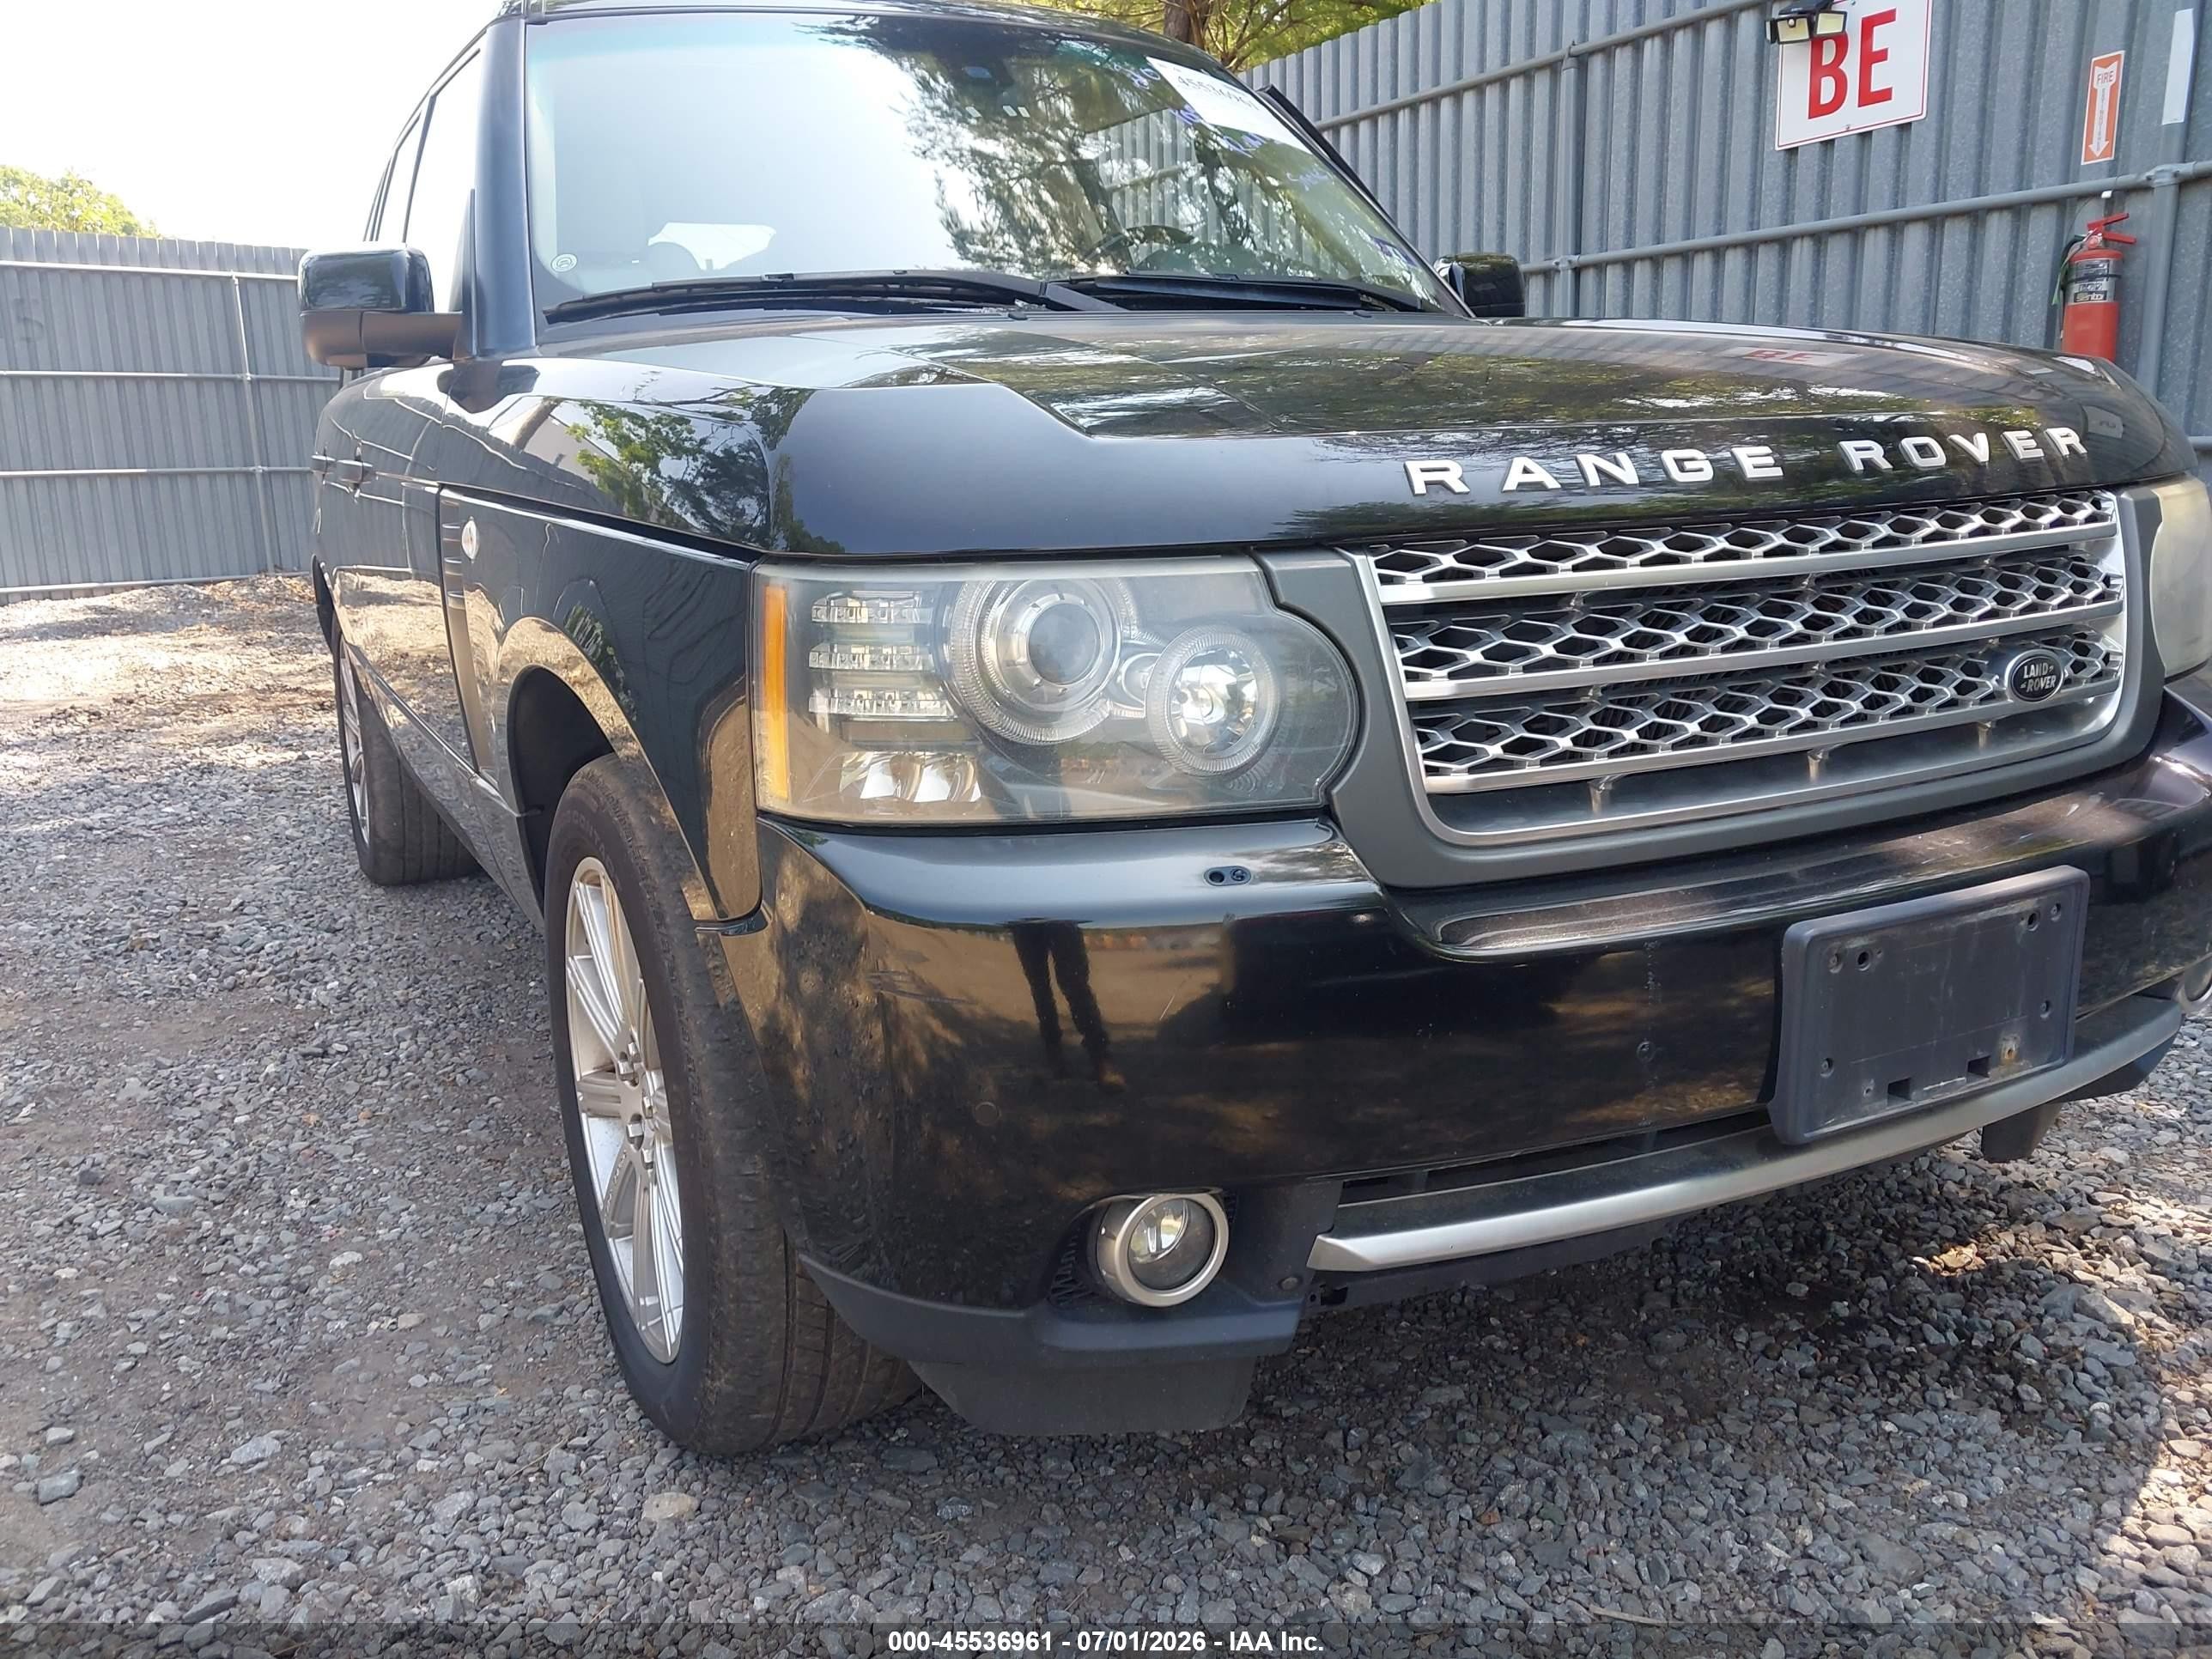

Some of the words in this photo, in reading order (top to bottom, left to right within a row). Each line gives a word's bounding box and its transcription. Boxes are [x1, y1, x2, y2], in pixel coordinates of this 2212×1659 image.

[1808, 7, 1897, 119] BE
[2097, 70, 2114, 84] FIRE
[1402, 445, 1784, 496] RANGE
[1837, 427, 2088, 473] ROVER
[2023, 662, 2049, 679] LAND
[2026, 675, 2057, 693] ROVER
